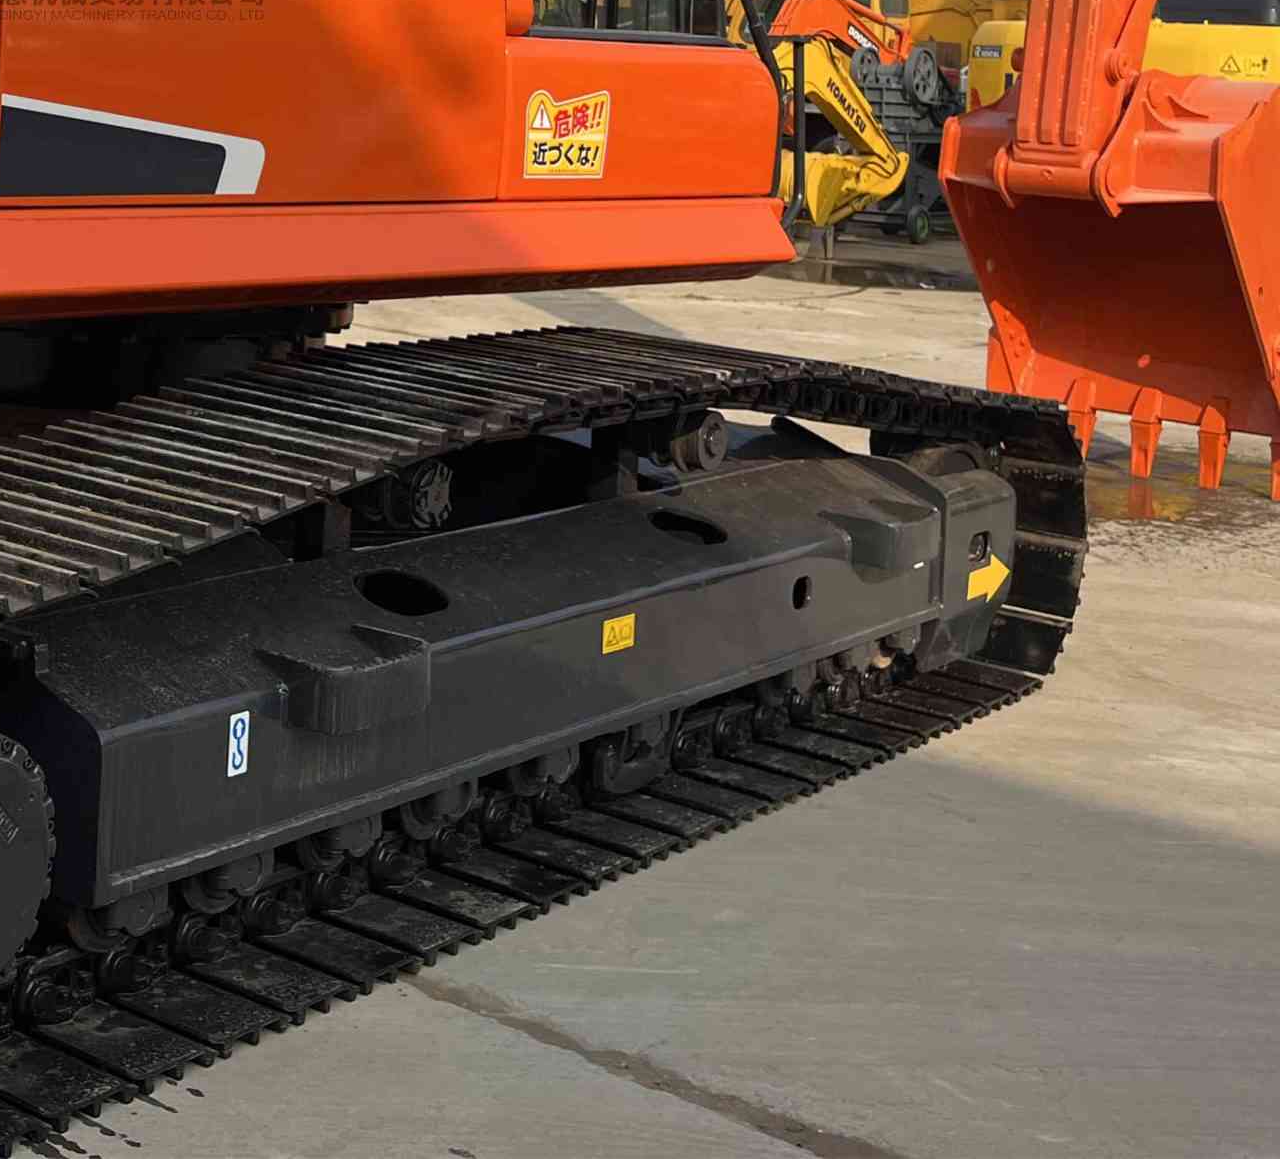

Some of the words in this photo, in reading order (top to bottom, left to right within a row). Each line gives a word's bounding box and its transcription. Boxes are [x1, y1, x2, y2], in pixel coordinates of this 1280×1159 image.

[827, 78, 866, 133] KOMATSU
[532, 142, 599, 167] 近づくな!
